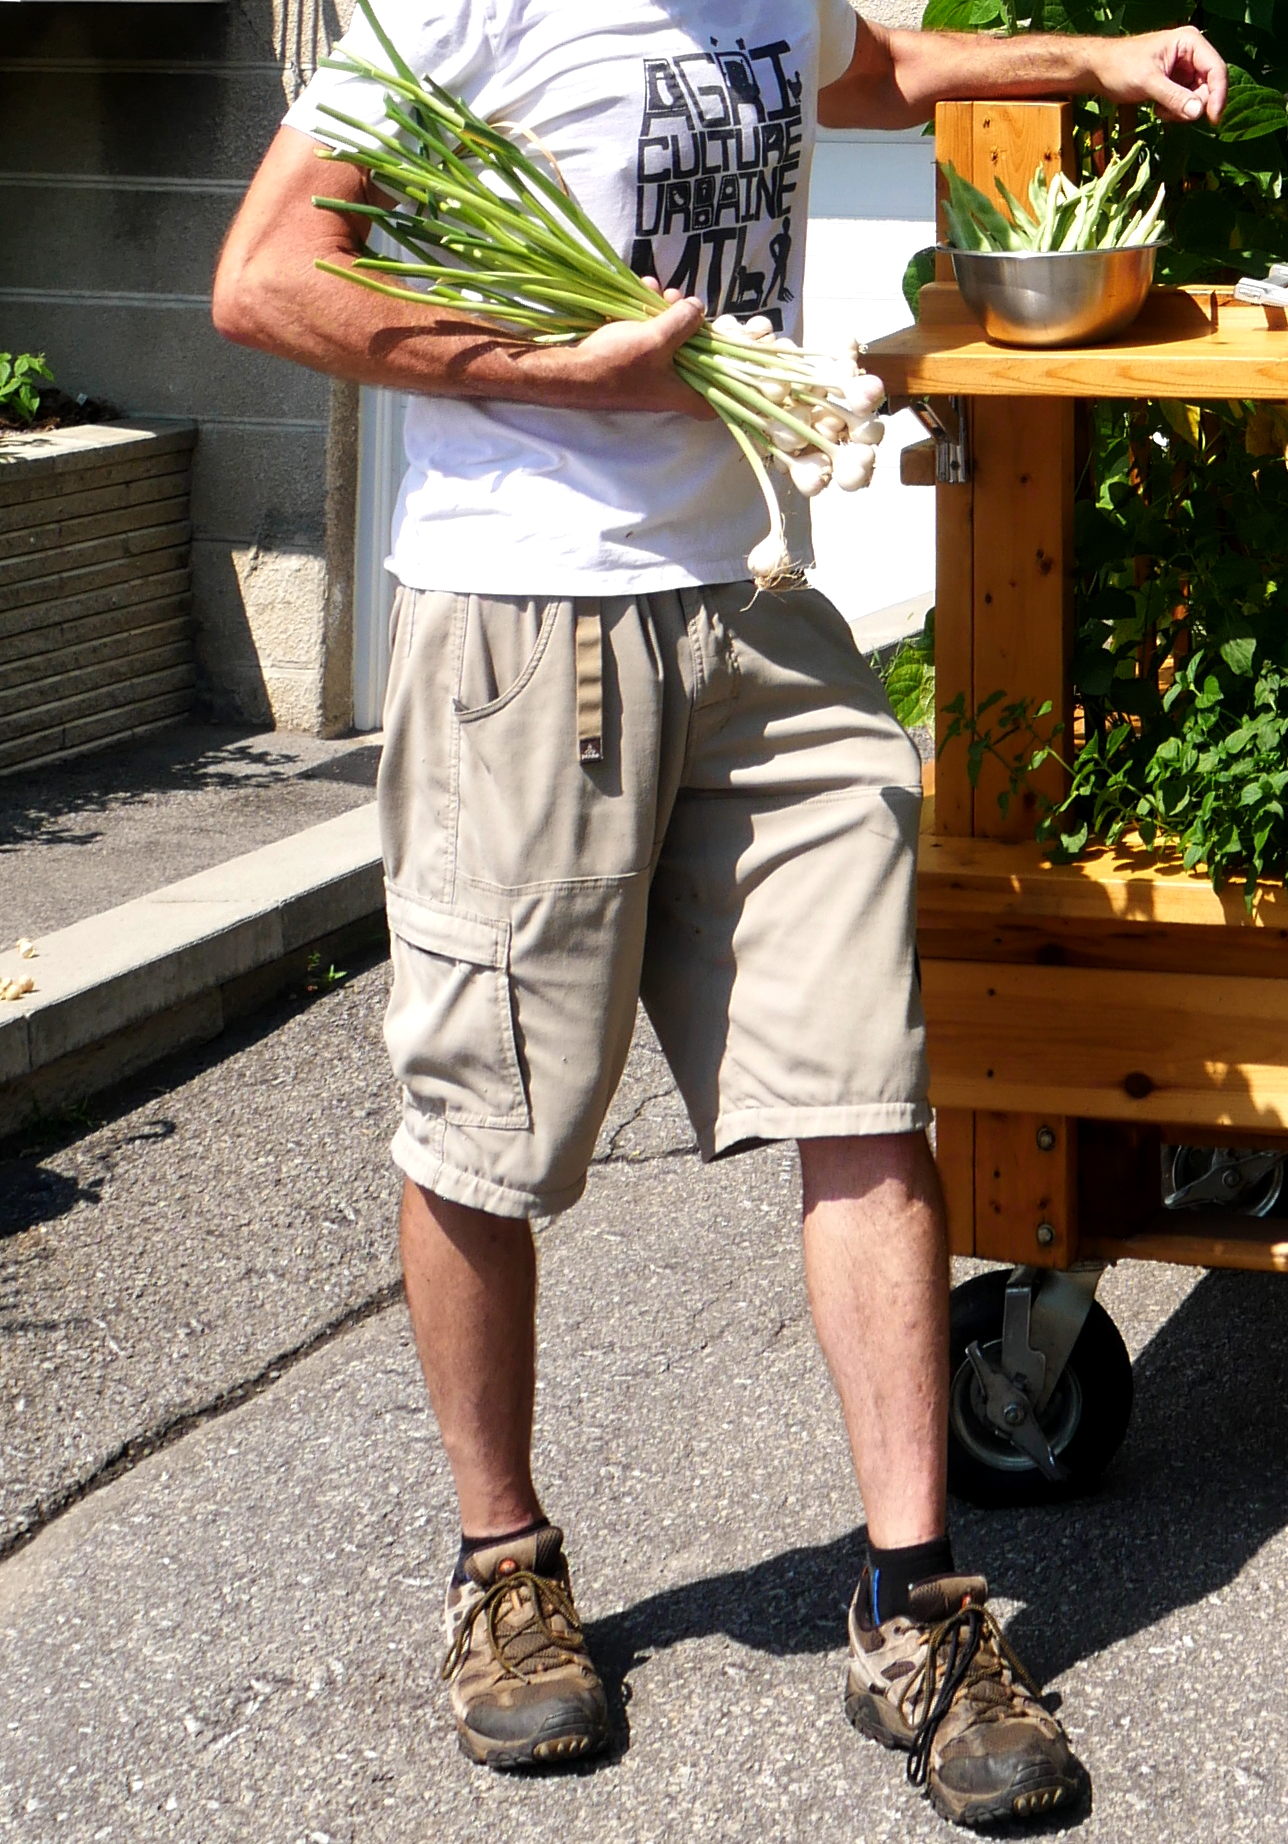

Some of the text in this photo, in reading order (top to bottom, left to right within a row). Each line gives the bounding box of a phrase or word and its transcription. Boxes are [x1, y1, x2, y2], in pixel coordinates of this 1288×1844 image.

[637, 117, 802, 184] CULTURE
[636, 159, 799, 236] URBAINE
[629, 226, 763, 316] MTL
